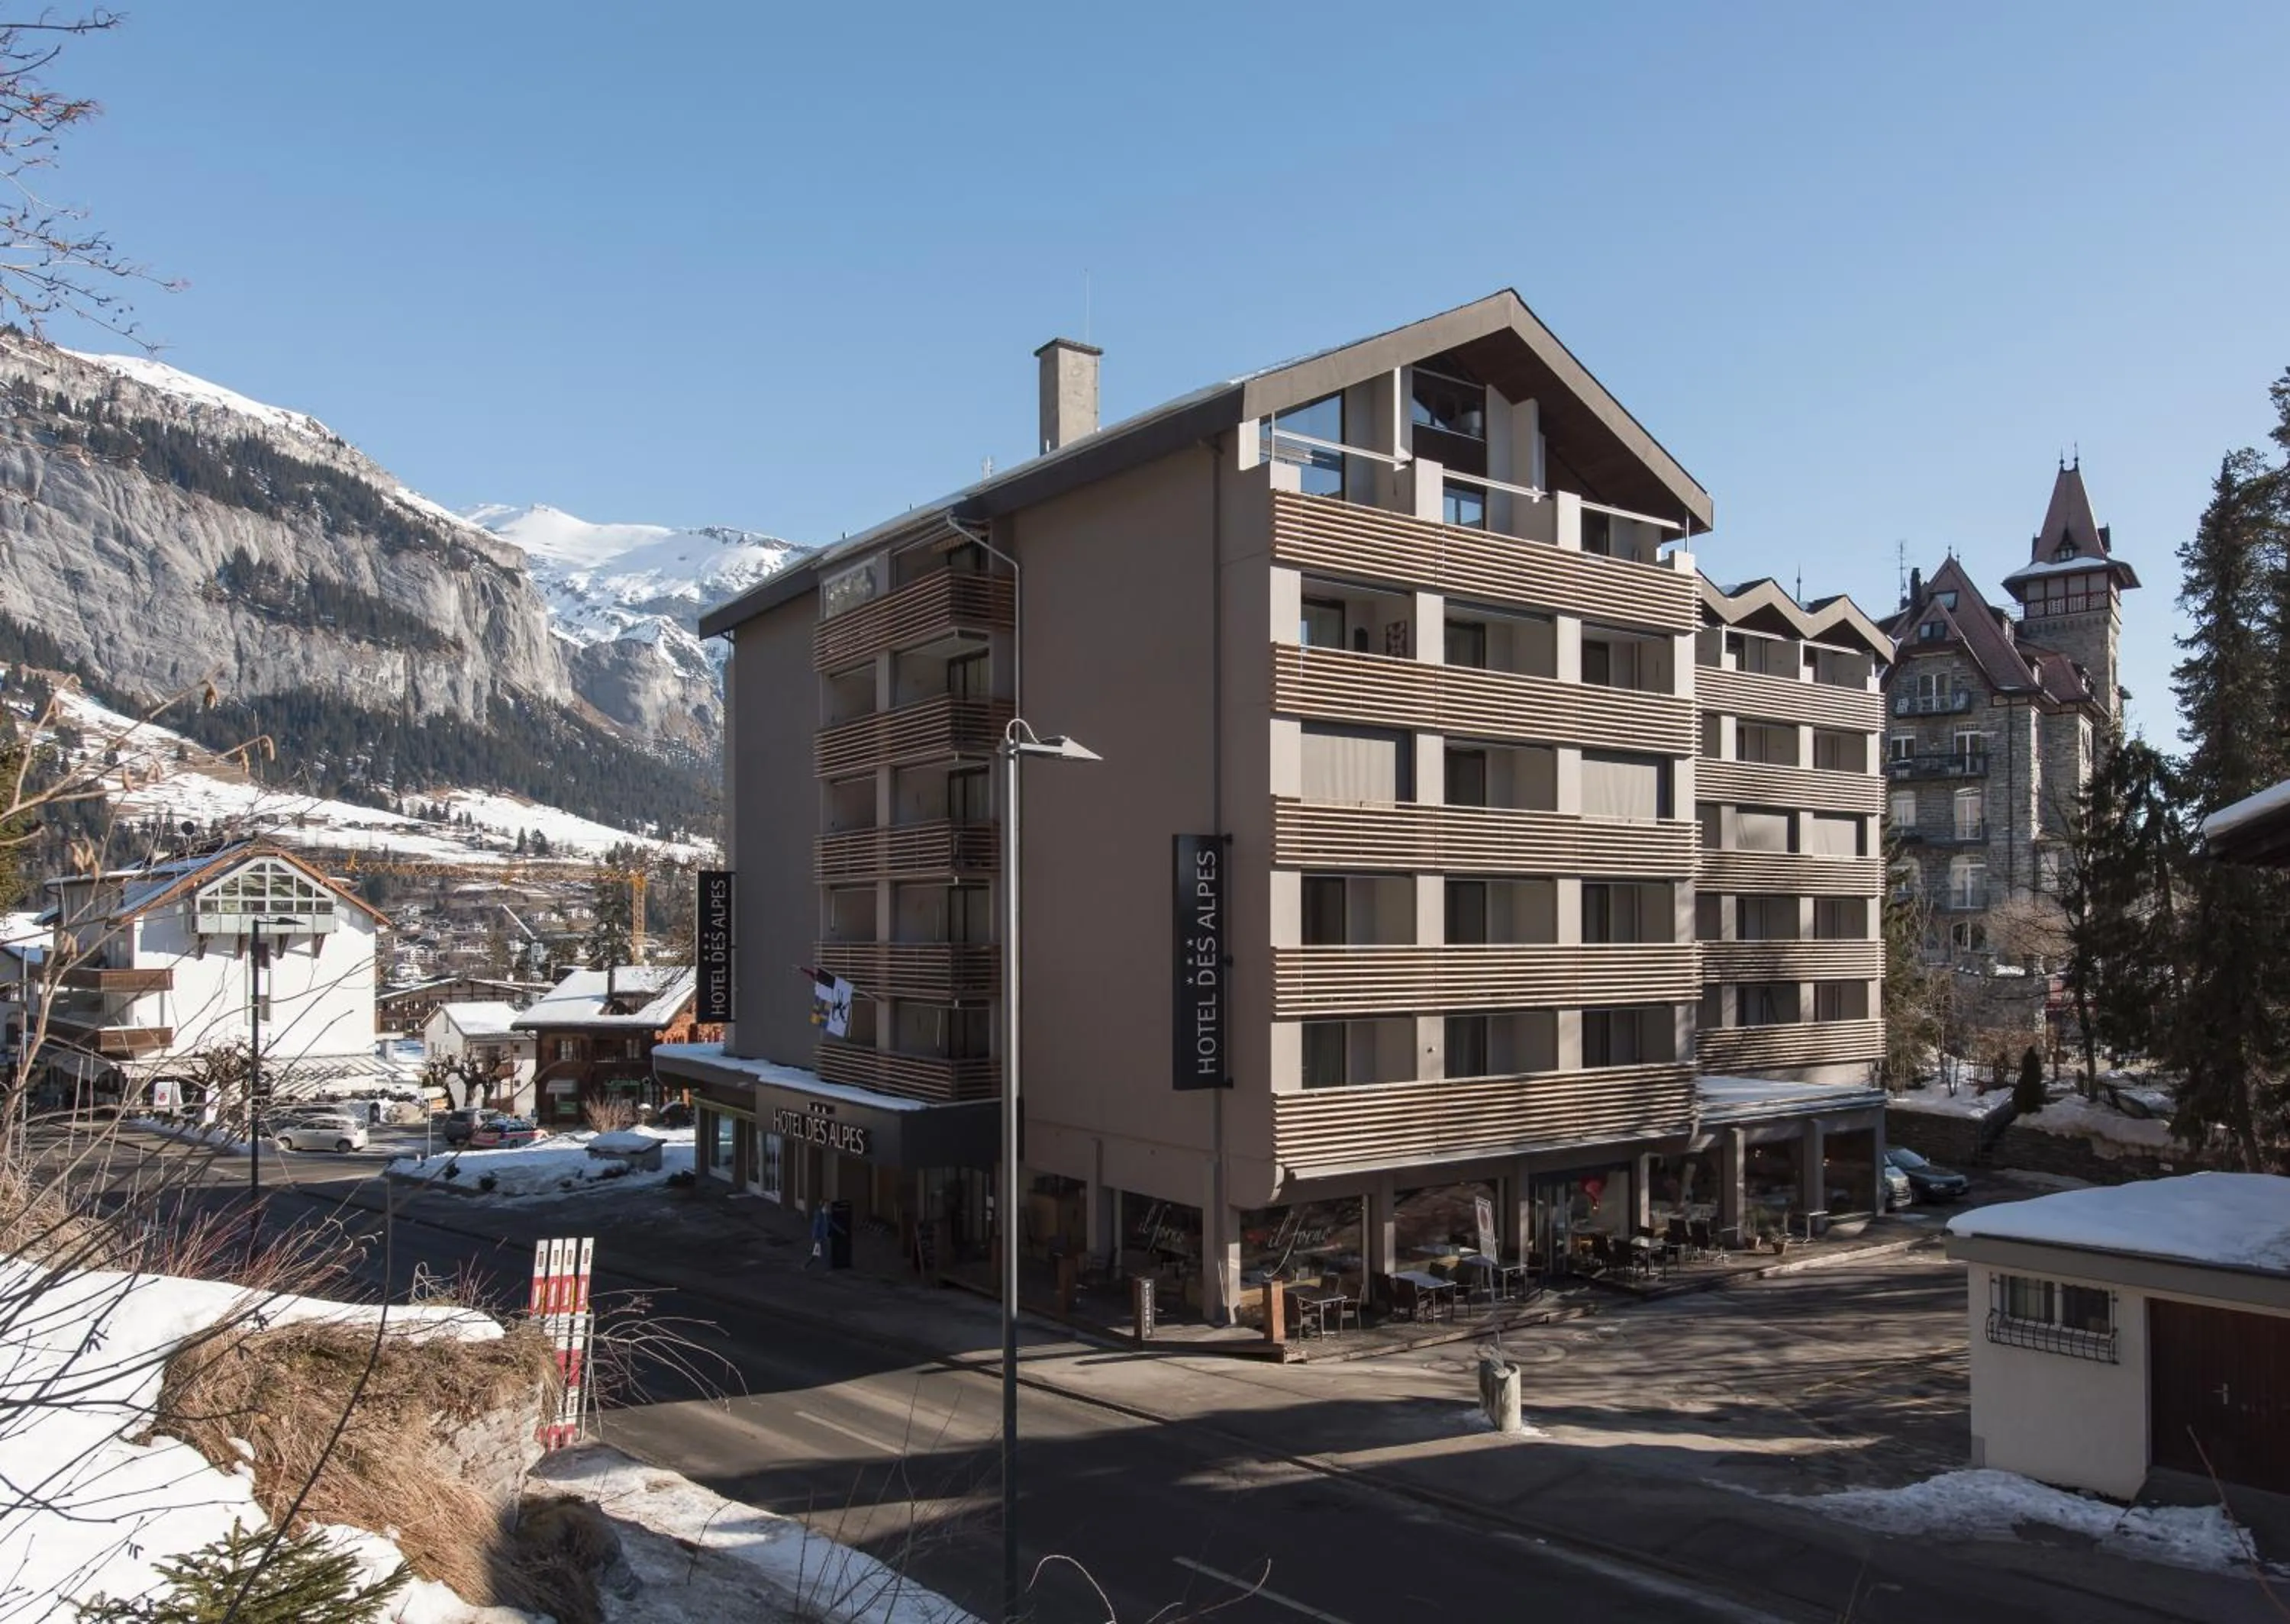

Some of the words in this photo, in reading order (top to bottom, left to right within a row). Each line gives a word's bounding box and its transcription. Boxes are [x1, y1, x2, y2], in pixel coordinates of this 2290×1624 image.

[711, 879, 726, 928] ALPES
[1196, 850, 1216, 930] ALPES
[711, 930, 726, 962] DES
[1197, 936, 1216, 986] DES
[711, 965, 726, 1014] HOTEL
[1198, 994, 1216, 1075] HOTEL
[773, 1107, 804, 1139] HOTEL
[805, 1116, 827, 1146] DES
[828, 1123, 864, 1155] ALPES
